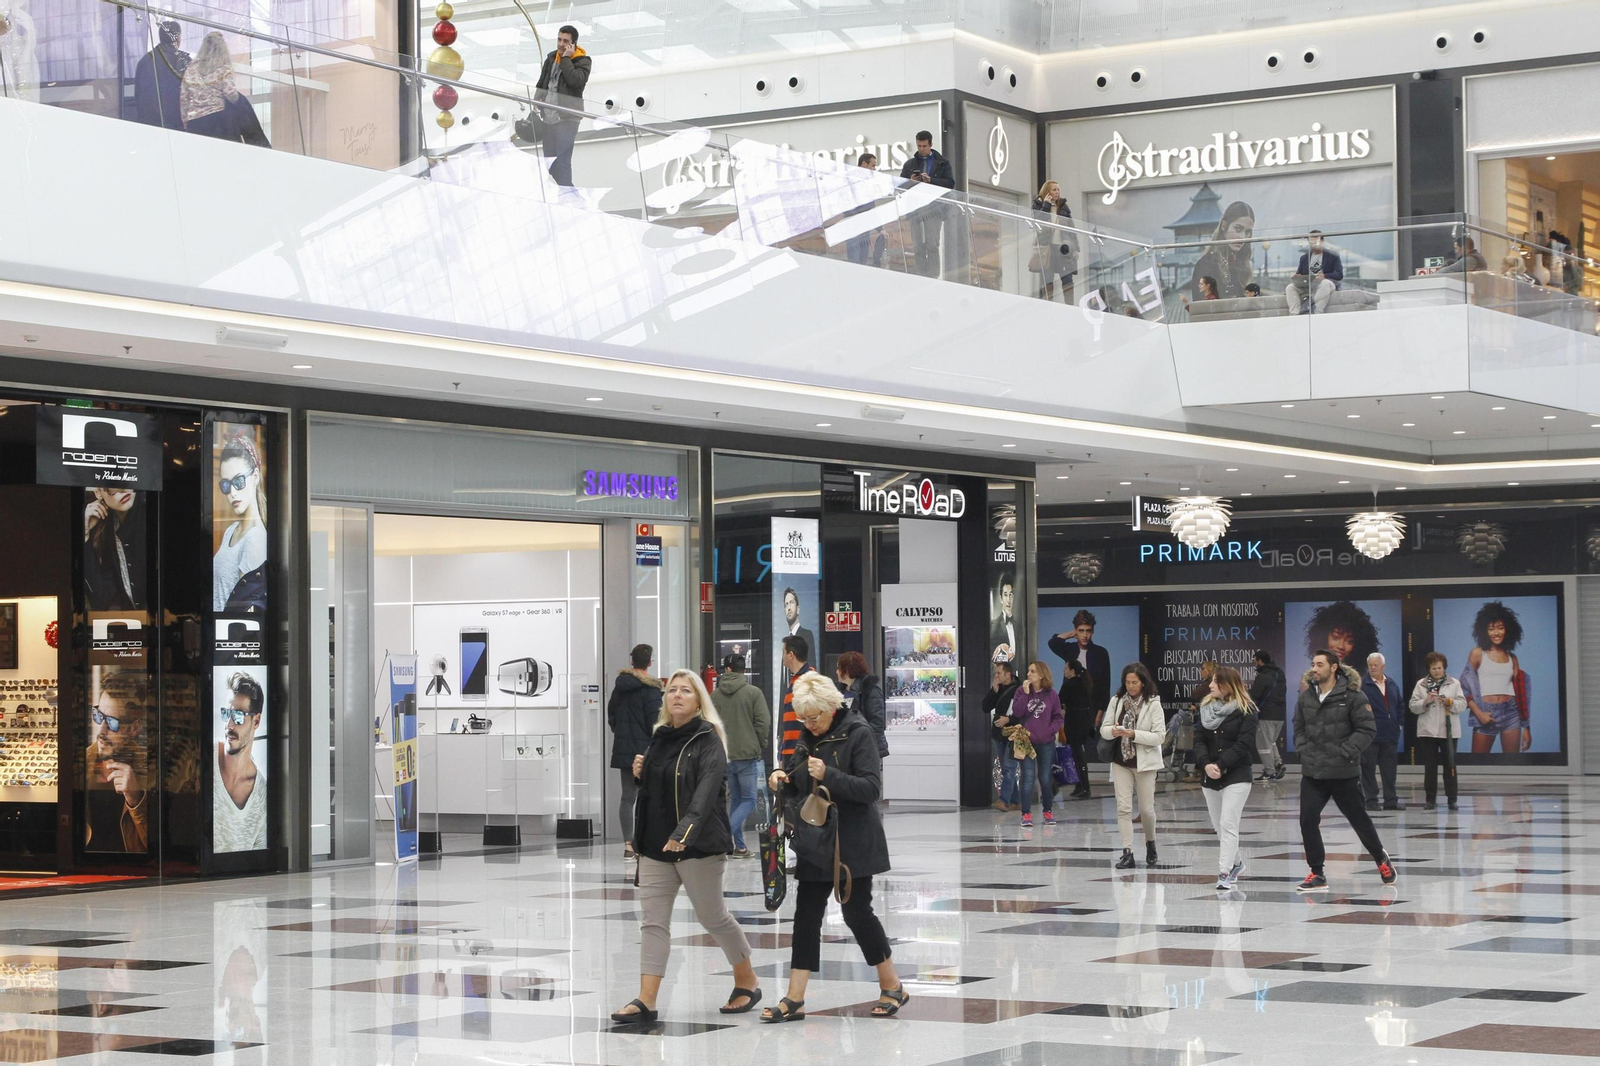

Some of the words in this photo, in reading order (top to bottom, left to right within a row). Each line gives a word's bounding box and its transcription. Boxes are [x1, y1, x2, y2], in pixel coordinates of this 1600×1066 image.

[1125, 122, 1370, 179] stradivarius
[62, 451, 138, 465] roberto
[583, 469, 678, 501] SAMSUNG
[1143, 502, 1162, 514] PLAZA
[1146, 516, 1161, 526] PLAZA
[780, 546, 811, 559] FESTINA
[994, 552, 1016, 562] LOTUS
[1140, 540, 1263, 563] PRIMARK
[895, 606, 943, 617] CALYPSO
[1166, 604, 1200, 618] TRABAJA
[1203, 603, 1218, 617] CON
[1221, 602, 1259, 617] NOSOTROS
[1164, 626, 1256, 641] PRIMARK
[1212, 649, 1218, 663] A
[1220, 648, 1261, 664] PERSONA
[1157, 666, 1174, 682] CON
